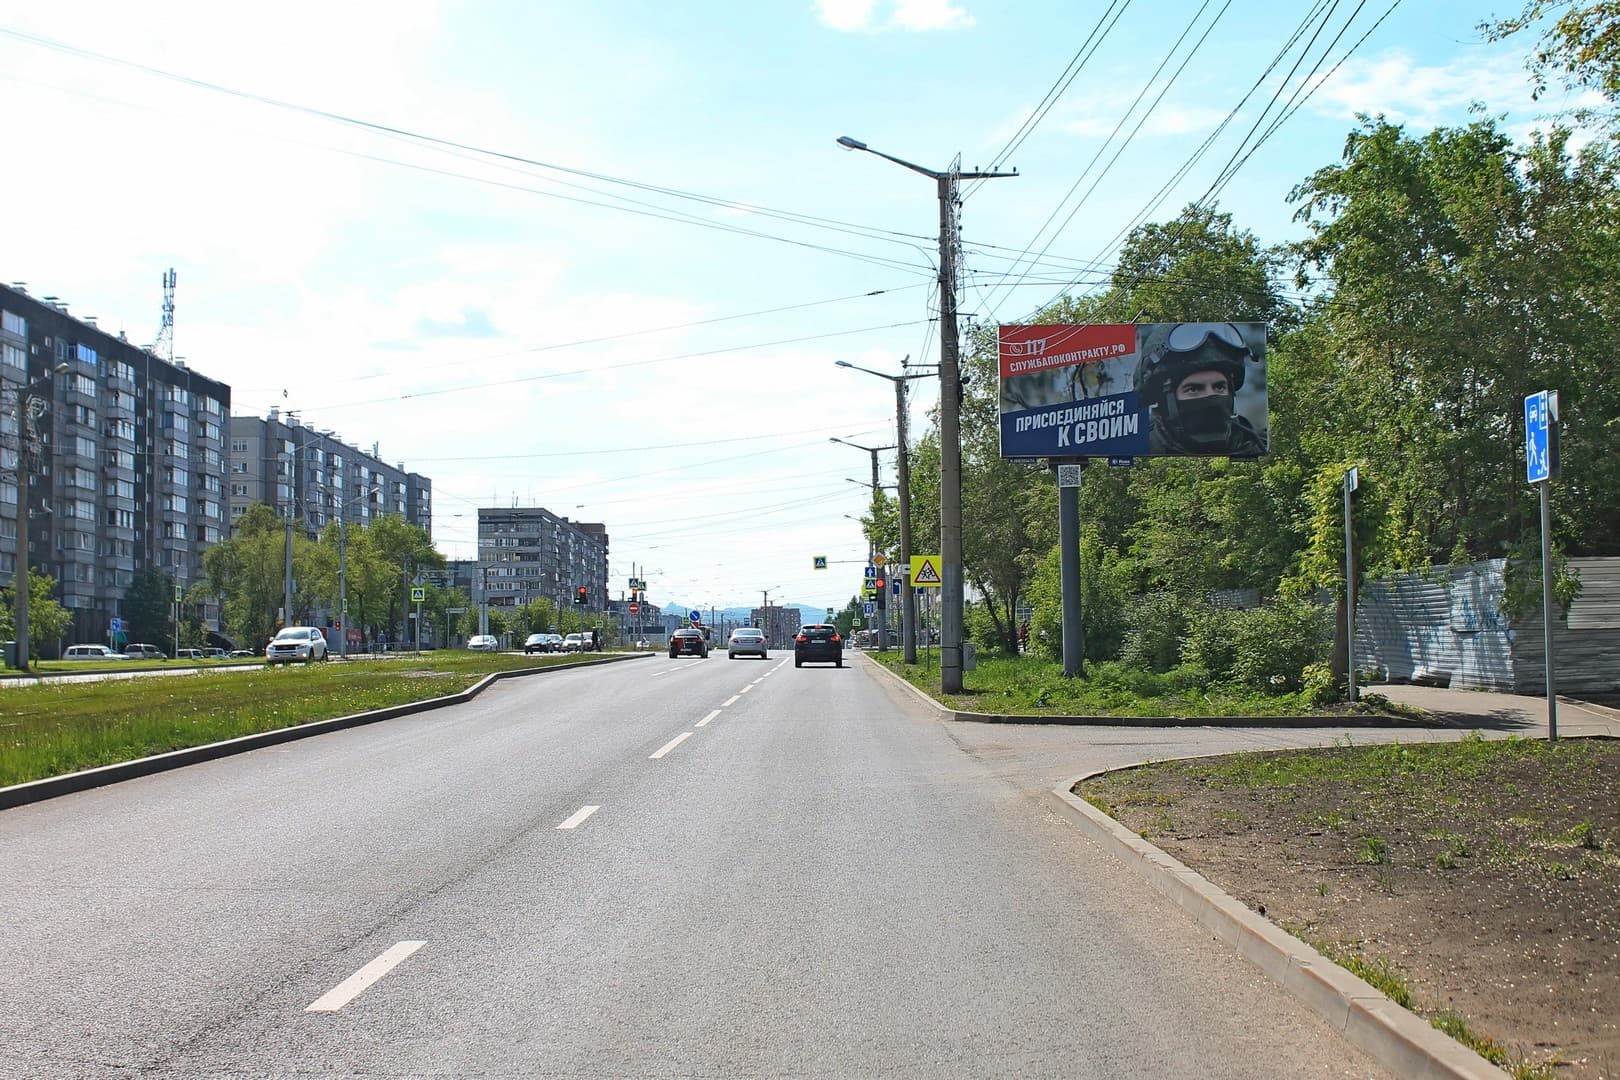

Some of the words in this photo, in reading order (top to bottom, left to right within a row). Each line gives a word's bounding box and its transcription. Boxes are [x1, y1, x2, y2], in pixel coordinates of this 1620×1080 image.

[1010, 343, 1126, 372] СЛУЖБАПОКОНТРАКТУ.РФ
[1026, 339, 1047, 355] 117
[1016, 399, 1125, 433] ПРИСОЕДИНЯЙСЯ
[1058, 425, 1070, 448] К
[1074, 413, 1139, 445] СВОИМ
